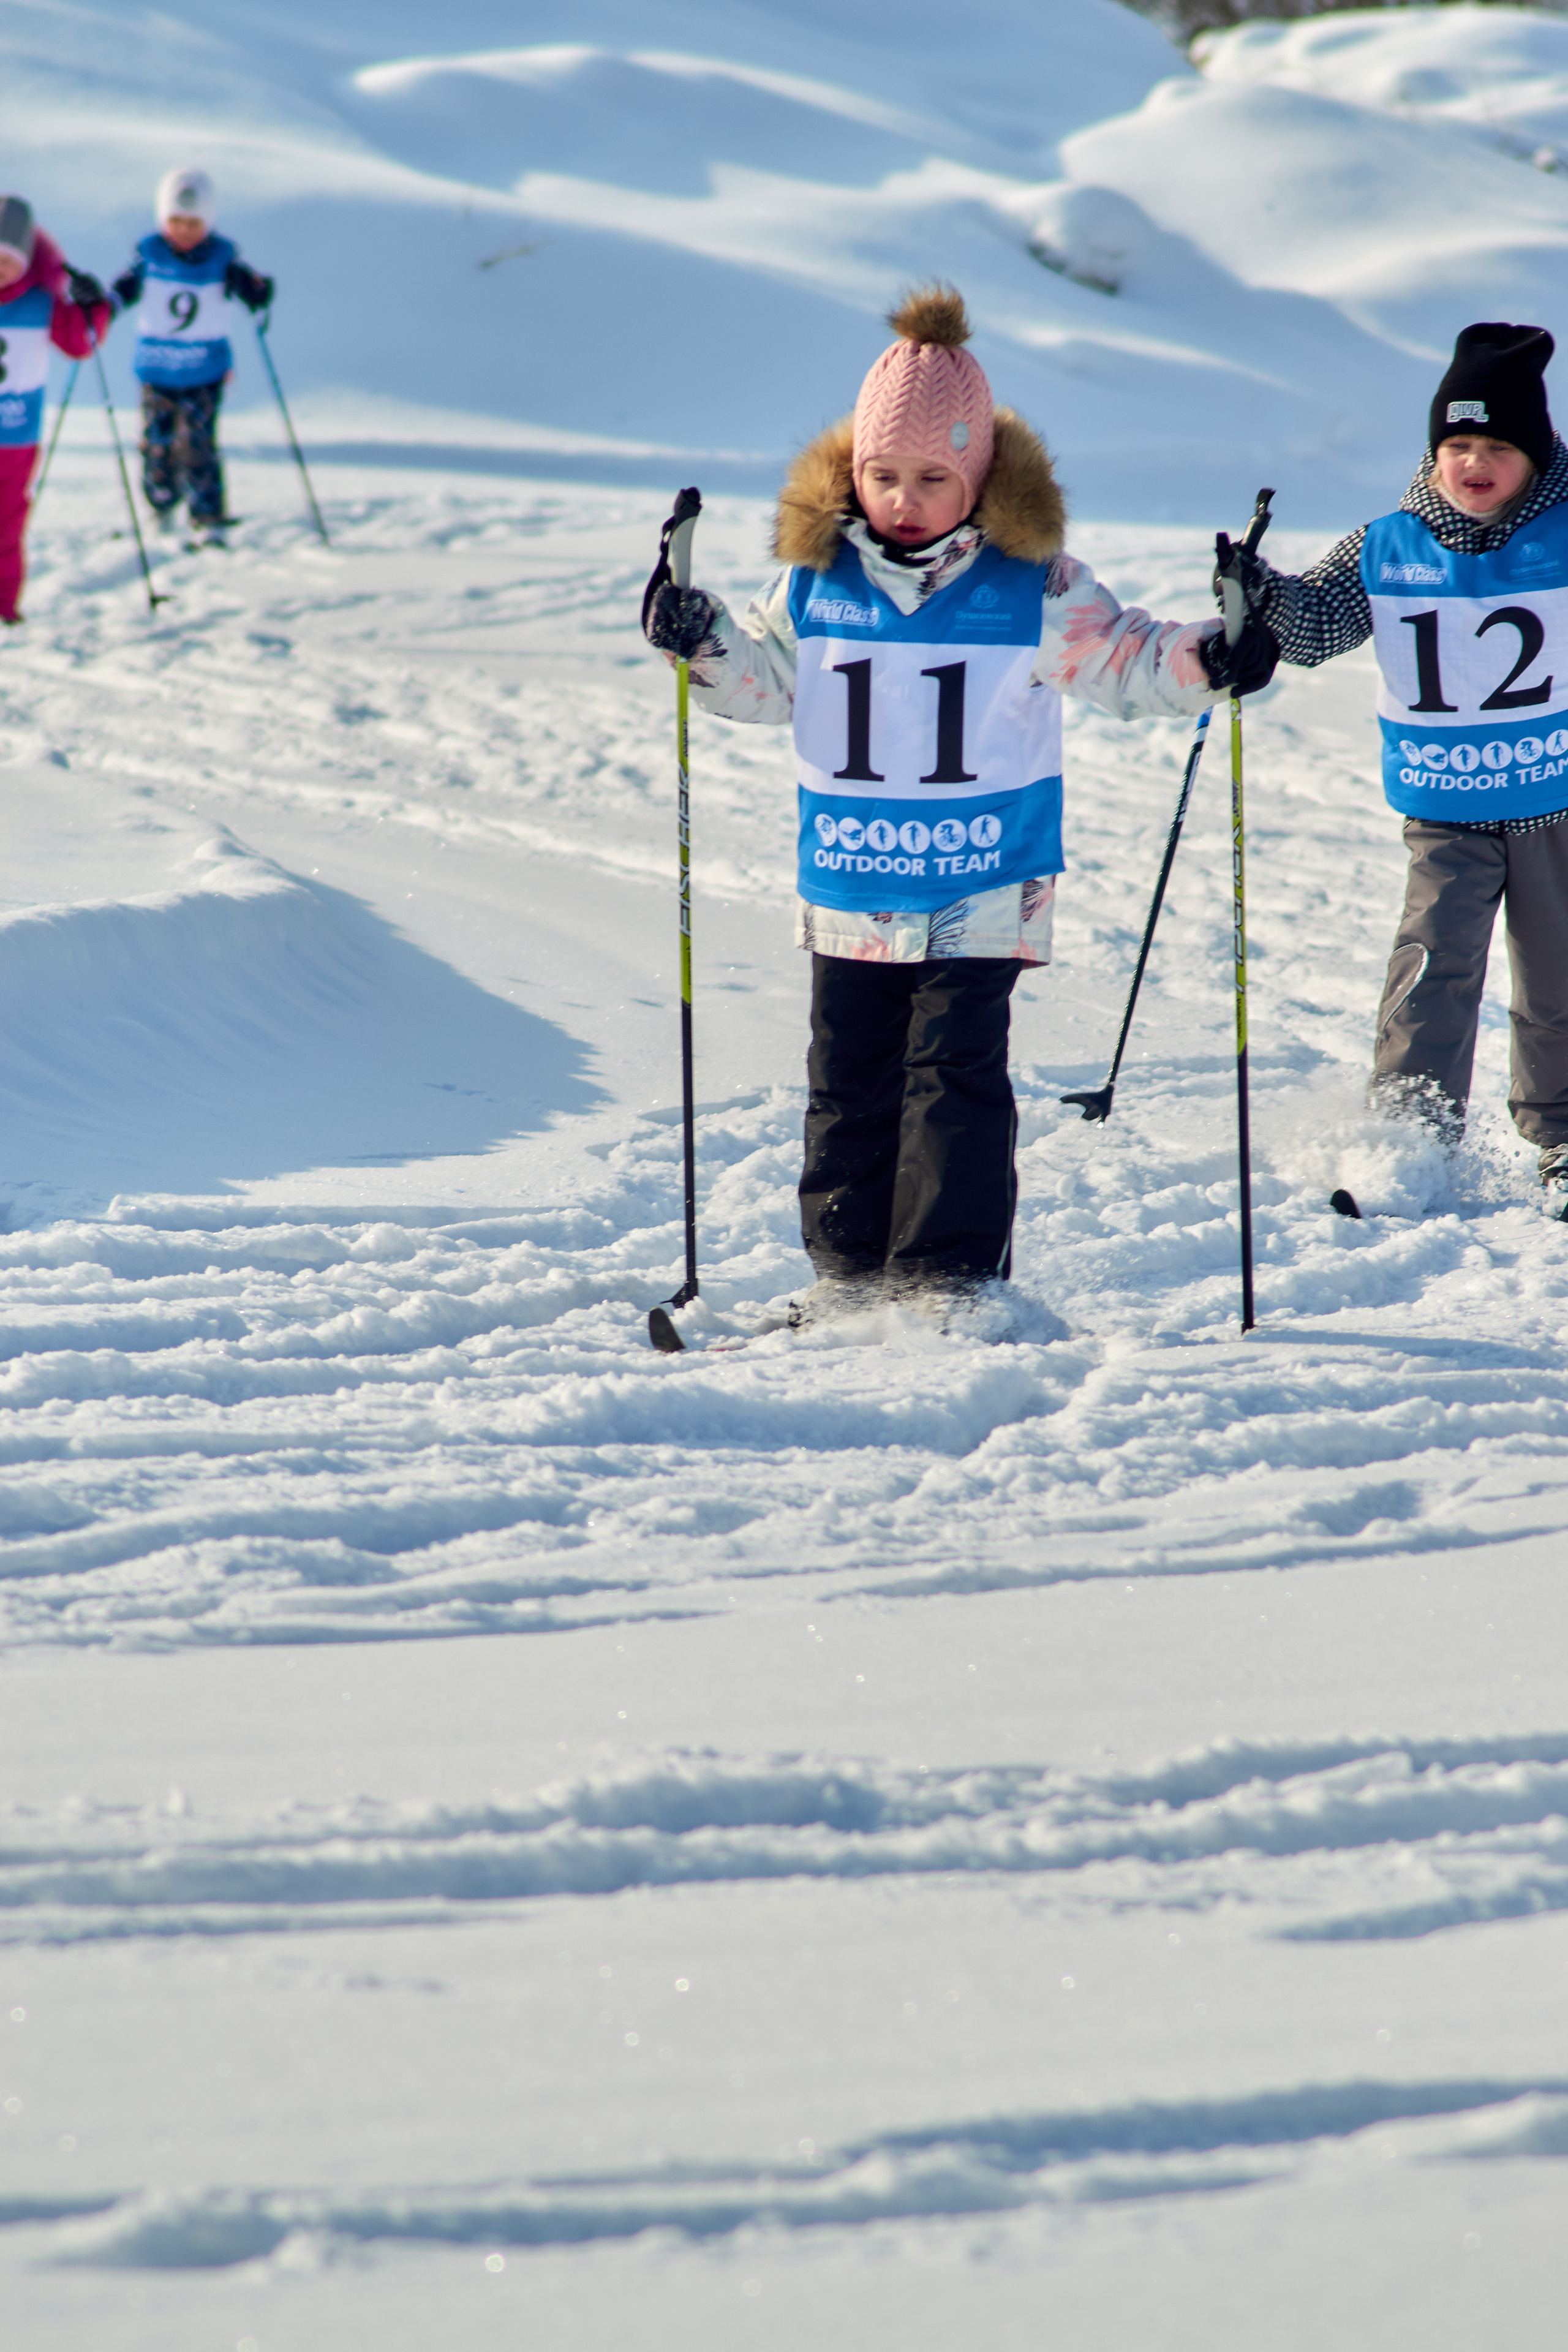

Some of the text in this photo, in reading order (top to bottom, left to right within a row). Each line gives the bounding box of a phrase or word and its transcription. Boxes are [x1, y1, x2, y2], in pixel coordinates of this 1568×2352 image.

[169, 290, 200, 334] 9
[809, 600, 879, 625] World Class
[1400, 605, 1554, 713] 12
[832, 657, 978, 784] 11
[1399, 767, 1509, 791] OUTDOOR
[813, 848, 1001, 876] OUTDOOR TEAM
